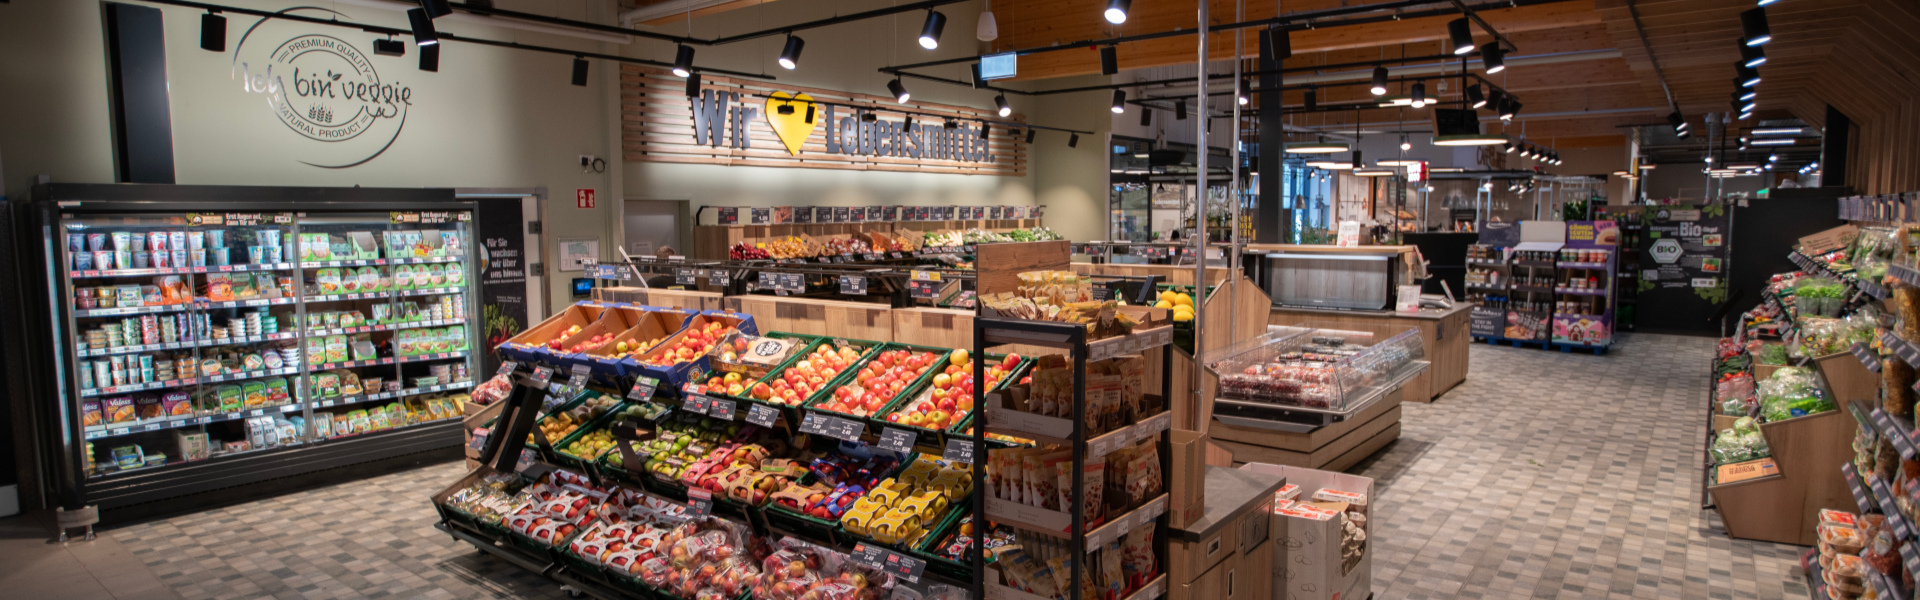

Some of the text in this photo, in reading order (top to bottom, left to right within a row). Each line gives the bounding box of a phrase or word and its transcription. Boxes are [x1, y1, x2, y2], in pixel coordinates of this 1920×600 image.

[289, 38, 371, 74] PREMIUM QUALITY
[294, 67, 335, 99] bin
[342, 81, 412, 118] veggie
[279, 103, 362, 138] NATURAL PRODUCT
[691, 89, 757, 150] Wir
[486, 238, 507, 247] Für Sie
[491, 248, 517, 257] wachsen
[491, 259, 501, 268] wir
